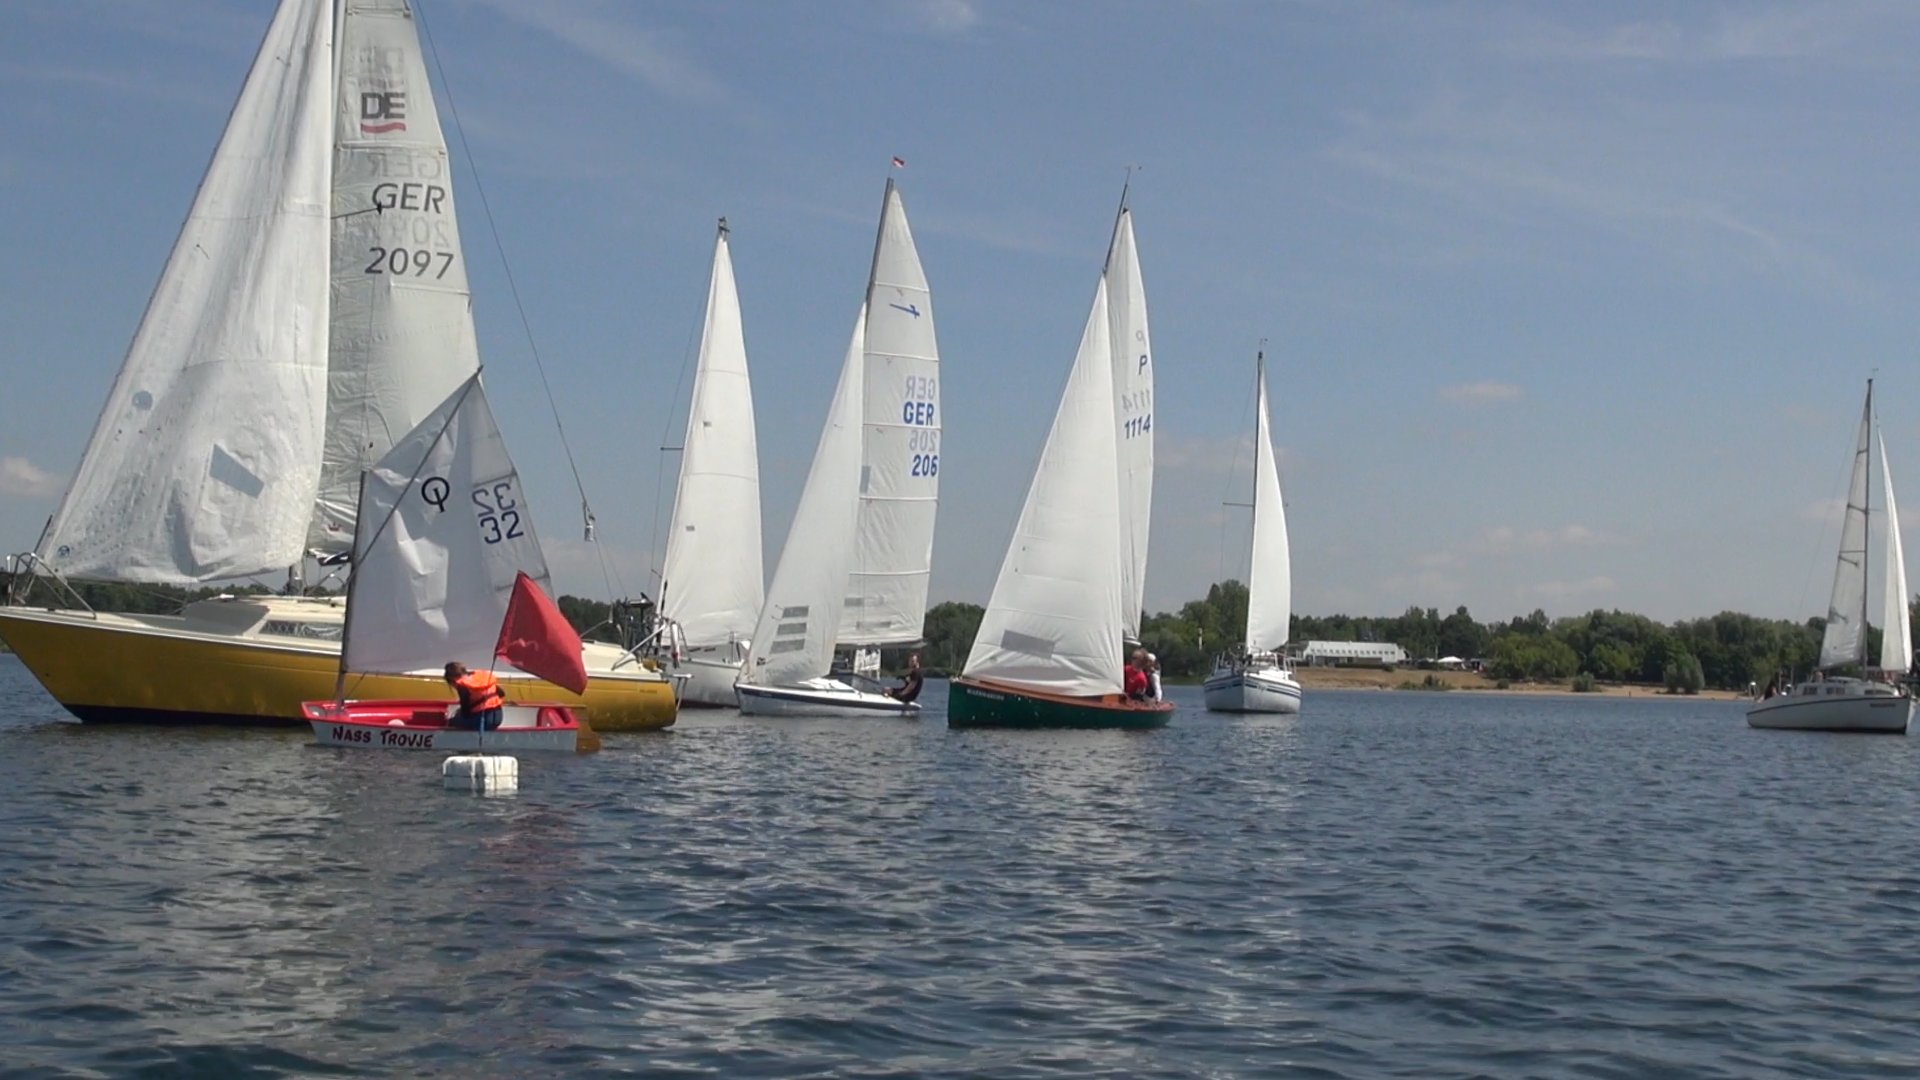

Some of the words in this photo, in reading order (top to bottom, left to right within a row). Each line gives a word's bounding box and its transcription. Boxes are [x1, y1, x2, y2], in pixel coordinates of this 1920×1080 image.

[361, 92, 405, 119] DE
[372, 183, 446, 214] GER
[364, 247, 454, 279] 2097
[1138, 354, 1148, 375] P
[903, 401, 935, 426] GER
[1124, 413, 1151, 440] 1114
[911, 454, 938, 477] 206
[480, 510, 524, 544] 32
